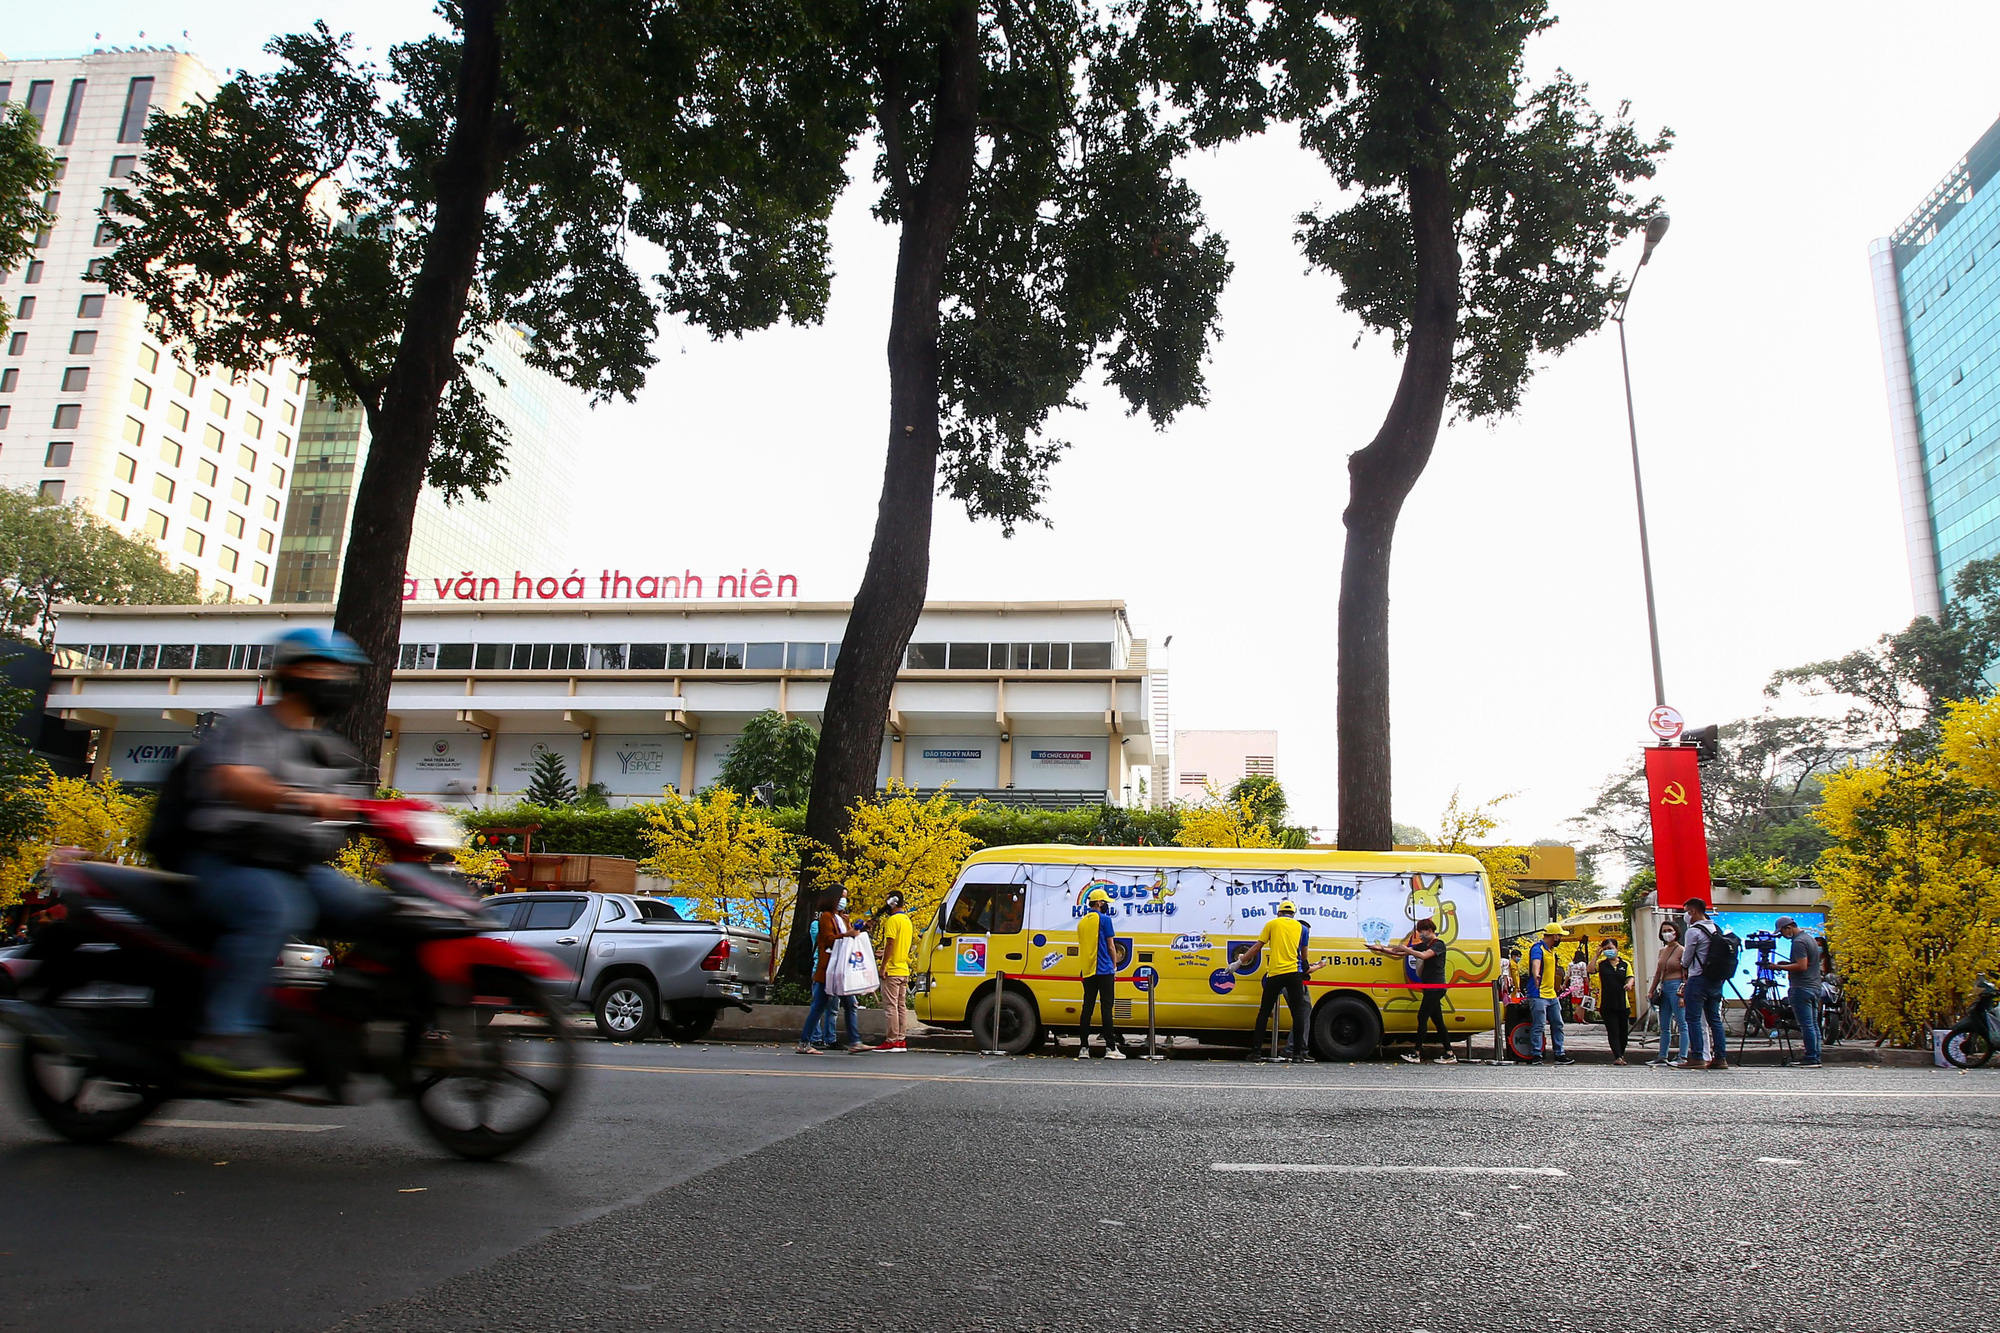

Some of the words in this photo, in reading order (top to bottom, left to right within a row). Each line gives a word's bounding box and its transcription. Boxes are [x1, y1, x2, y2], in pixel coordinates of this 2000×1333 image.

[434, 571, 500, 600] văn
[513, 568, 585, 599] hoá
[600, 569, 702, 598] thanh
[717, 568, 797, 597] niên
[629, 761, 662, 771] SPACE
[1302, 879, 1356, 900] Trang
[1123, 902, 1177, 917] Trang
[1241, 906, 1267, 918] Đón
[1300, 906, 1317, 916] an
[1318, 906, 1349, 920] toàn
